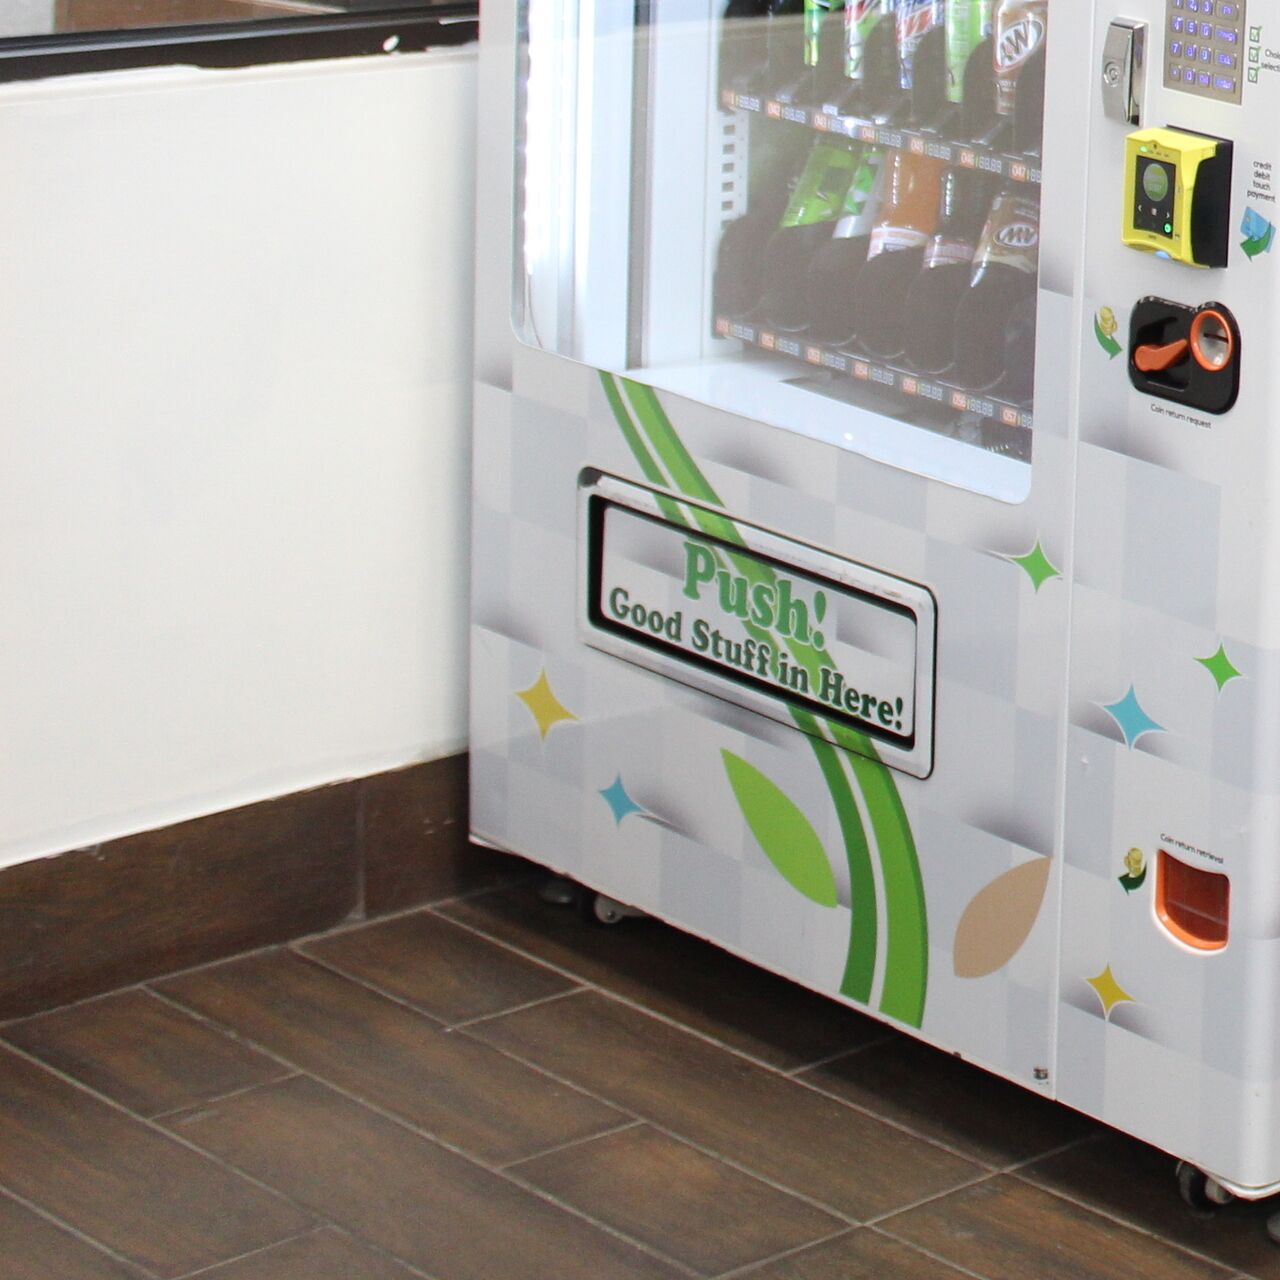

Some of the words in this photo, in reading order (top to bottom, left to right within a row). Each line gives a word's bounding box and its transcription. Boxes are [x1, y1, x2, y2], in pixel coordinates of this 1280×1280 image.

[1253, 160, 1272, 171] credit
[1253, 170, 1271, 181] debit
[1253, 180, 1271, 191] touch
[1247, 190, 1276, 203] payment
[1150, 403, 1164, 414] Coin
[1165, 407, 1186, 421] return
[1185, 414, 1212, 429] request
[683, 540, 827, 650] Push!
[609, 587, 682, 642] Good
[691, 619, 770, 679] Stuff
[777, 652, 810, 694] in
[818, 667, 904, 731] Here!
[1160, 833, 1175, 844] Coin
[1174, 840, 1197, 853] return
[1196, 849, 1224, 864] retrieval
